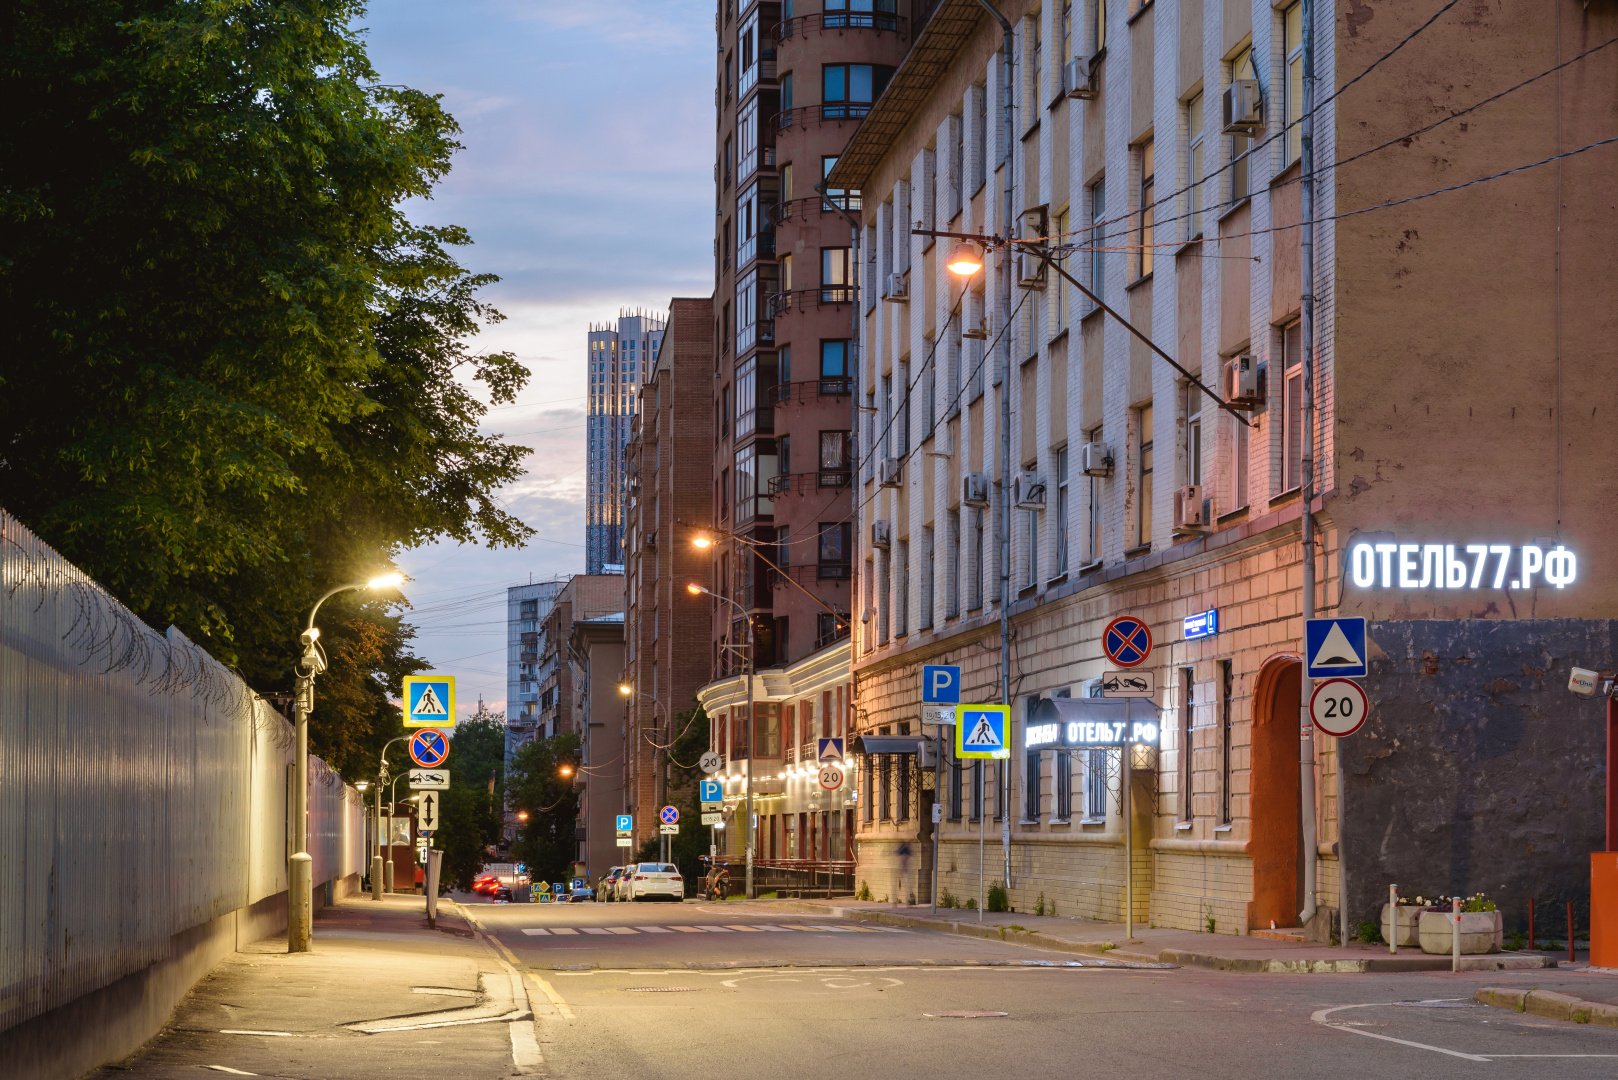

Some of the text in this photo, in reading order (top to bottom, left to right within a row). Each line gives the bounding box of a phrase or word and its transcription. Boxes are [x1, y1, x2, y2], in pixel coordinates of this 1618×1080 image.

[1352, 543, 1577, 589] ОТЕЛЬ77.РФ
[932, 670, 952, 698] P
[1324, 697, 1353, 717] 20
[704, 758, 717, 767] 20
[823, 772, 838, 782] 20
[706, 782, 718, 799] P
[620, 817, 629, 829] P
